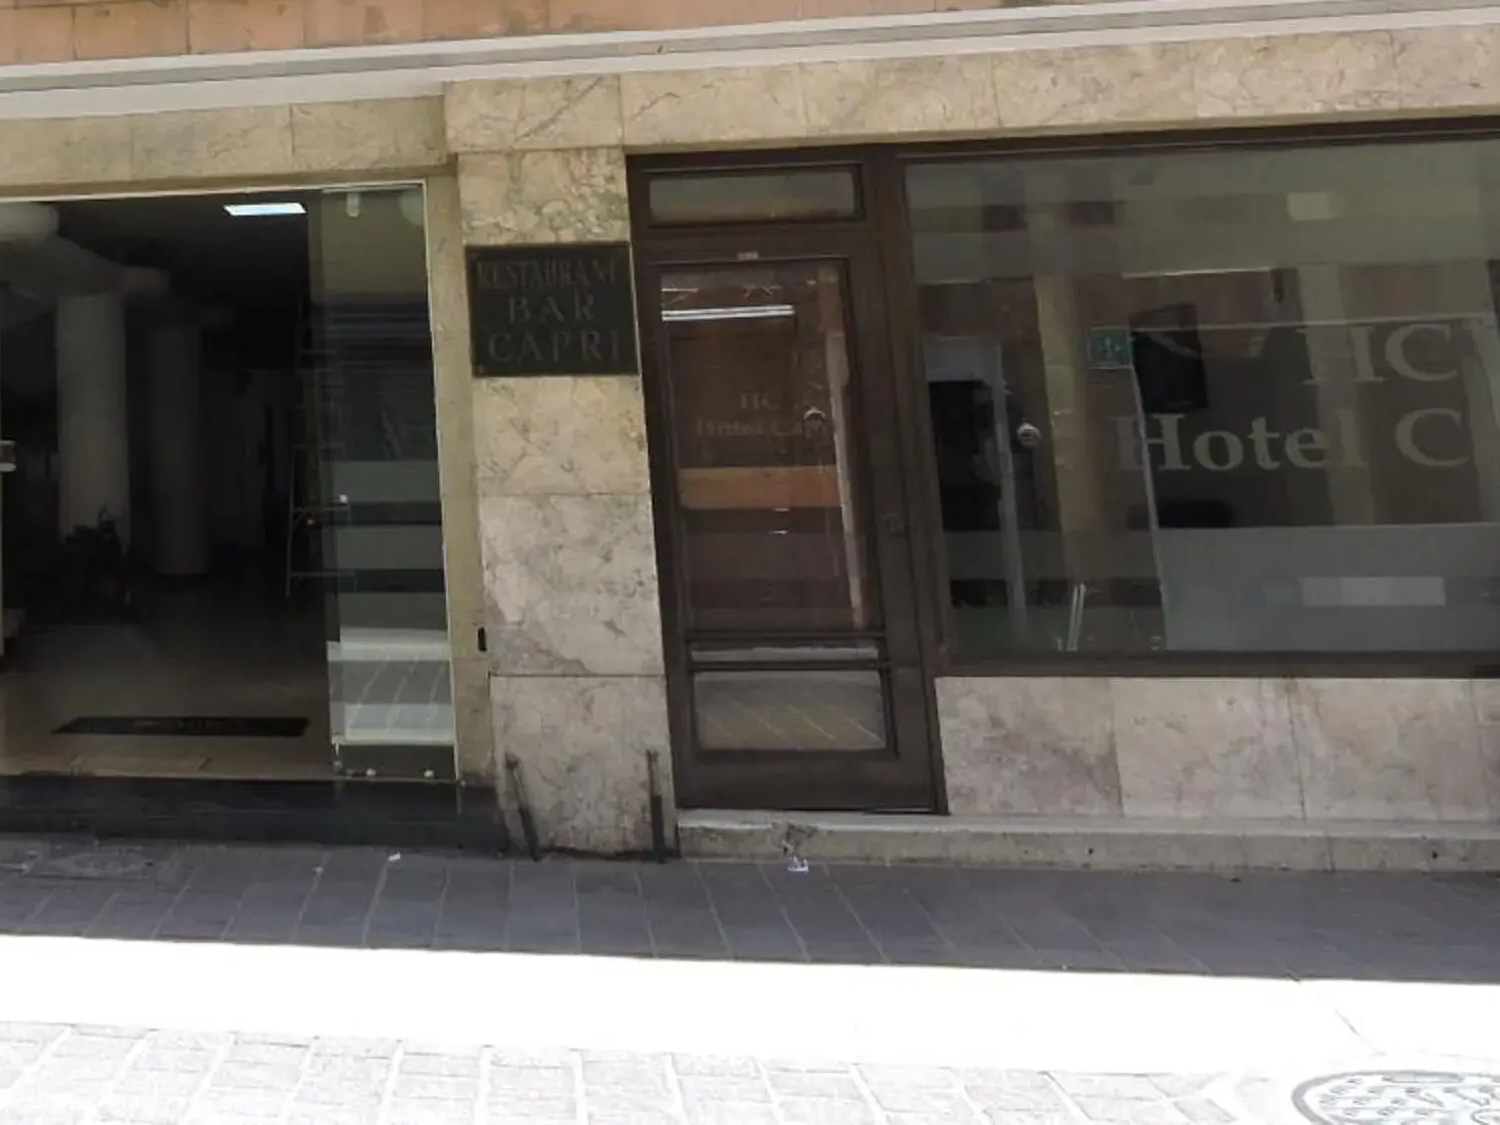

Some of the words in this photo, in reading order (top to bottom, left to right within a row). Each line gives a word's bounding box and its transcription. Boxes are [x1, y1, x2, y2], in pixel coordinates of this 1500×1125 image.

[508, 288, 596, 324] BAR
[488, 328, 622, 365] CAPRI
[1297, 322, 1458, 385] HC
[1109, 409, 1368, 472] Hotel
